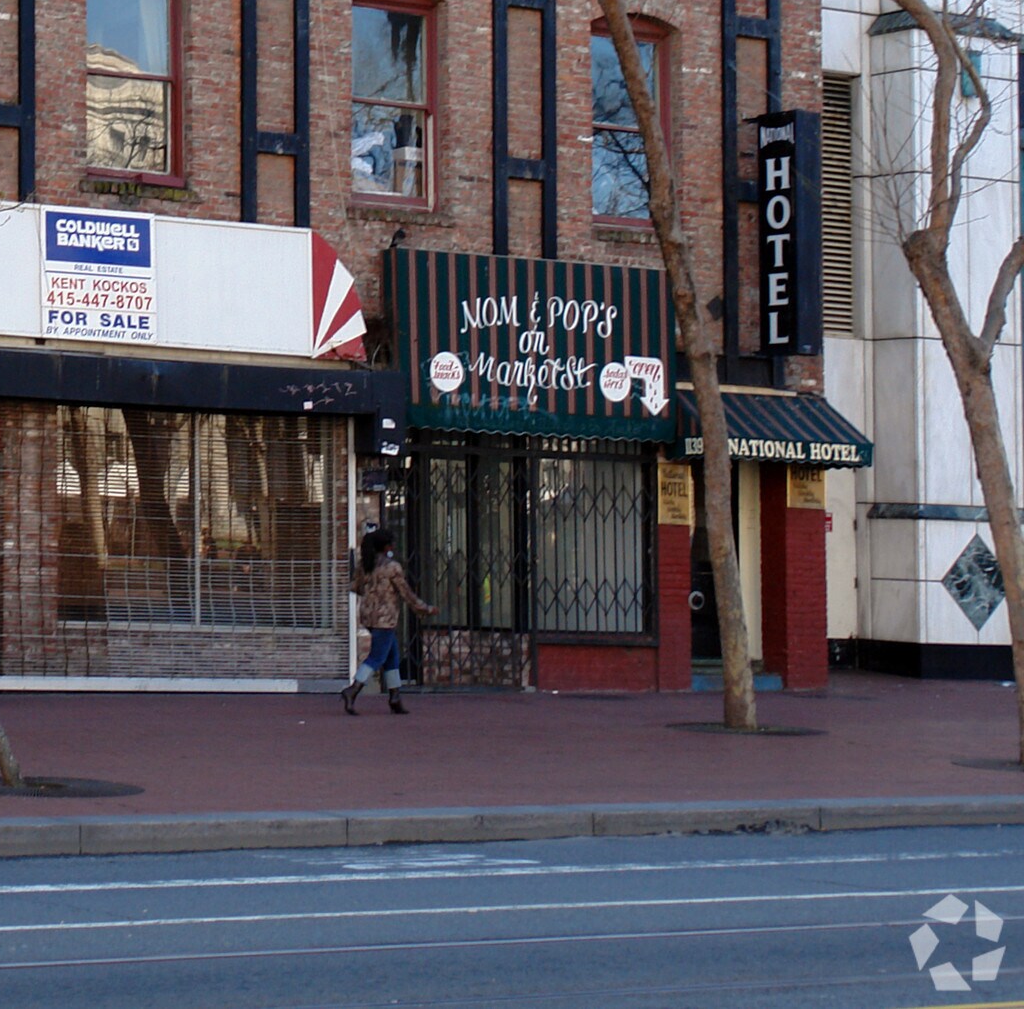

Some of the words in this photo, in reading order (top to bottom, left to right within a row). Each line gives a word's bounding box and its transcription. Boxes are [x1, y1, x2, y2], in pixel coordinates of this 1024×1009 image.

[765, 156, 791, 345] HOTEL
[74, 264, 93, 273] REAL
[97, 265, 123, 274] ESTATE
[51, 277, 86, 290] KENT
[92, 279, 147, 294] KOCKOS
[47, 290, 153, 311] 415-447-8707
[48, 310, 88, 326] FOR
[100, 313, 150, 330] SALE
[530, 291, 542, 333] &
[547, 296, 618, 338] POP'S
[46, 325, 59, 335] BY
[63, 327, 126, 340] APPOINTMENT
[130, 331, 154, 341] ONLY
[468, 352, 564, 405] Market
[728, 438, 806, 460] NATIONAL
[810, 443, 860, 463] HOTEL
[790, 465, 823, 482] HOTEL
[661, 481, 689, 497] HOTEL
